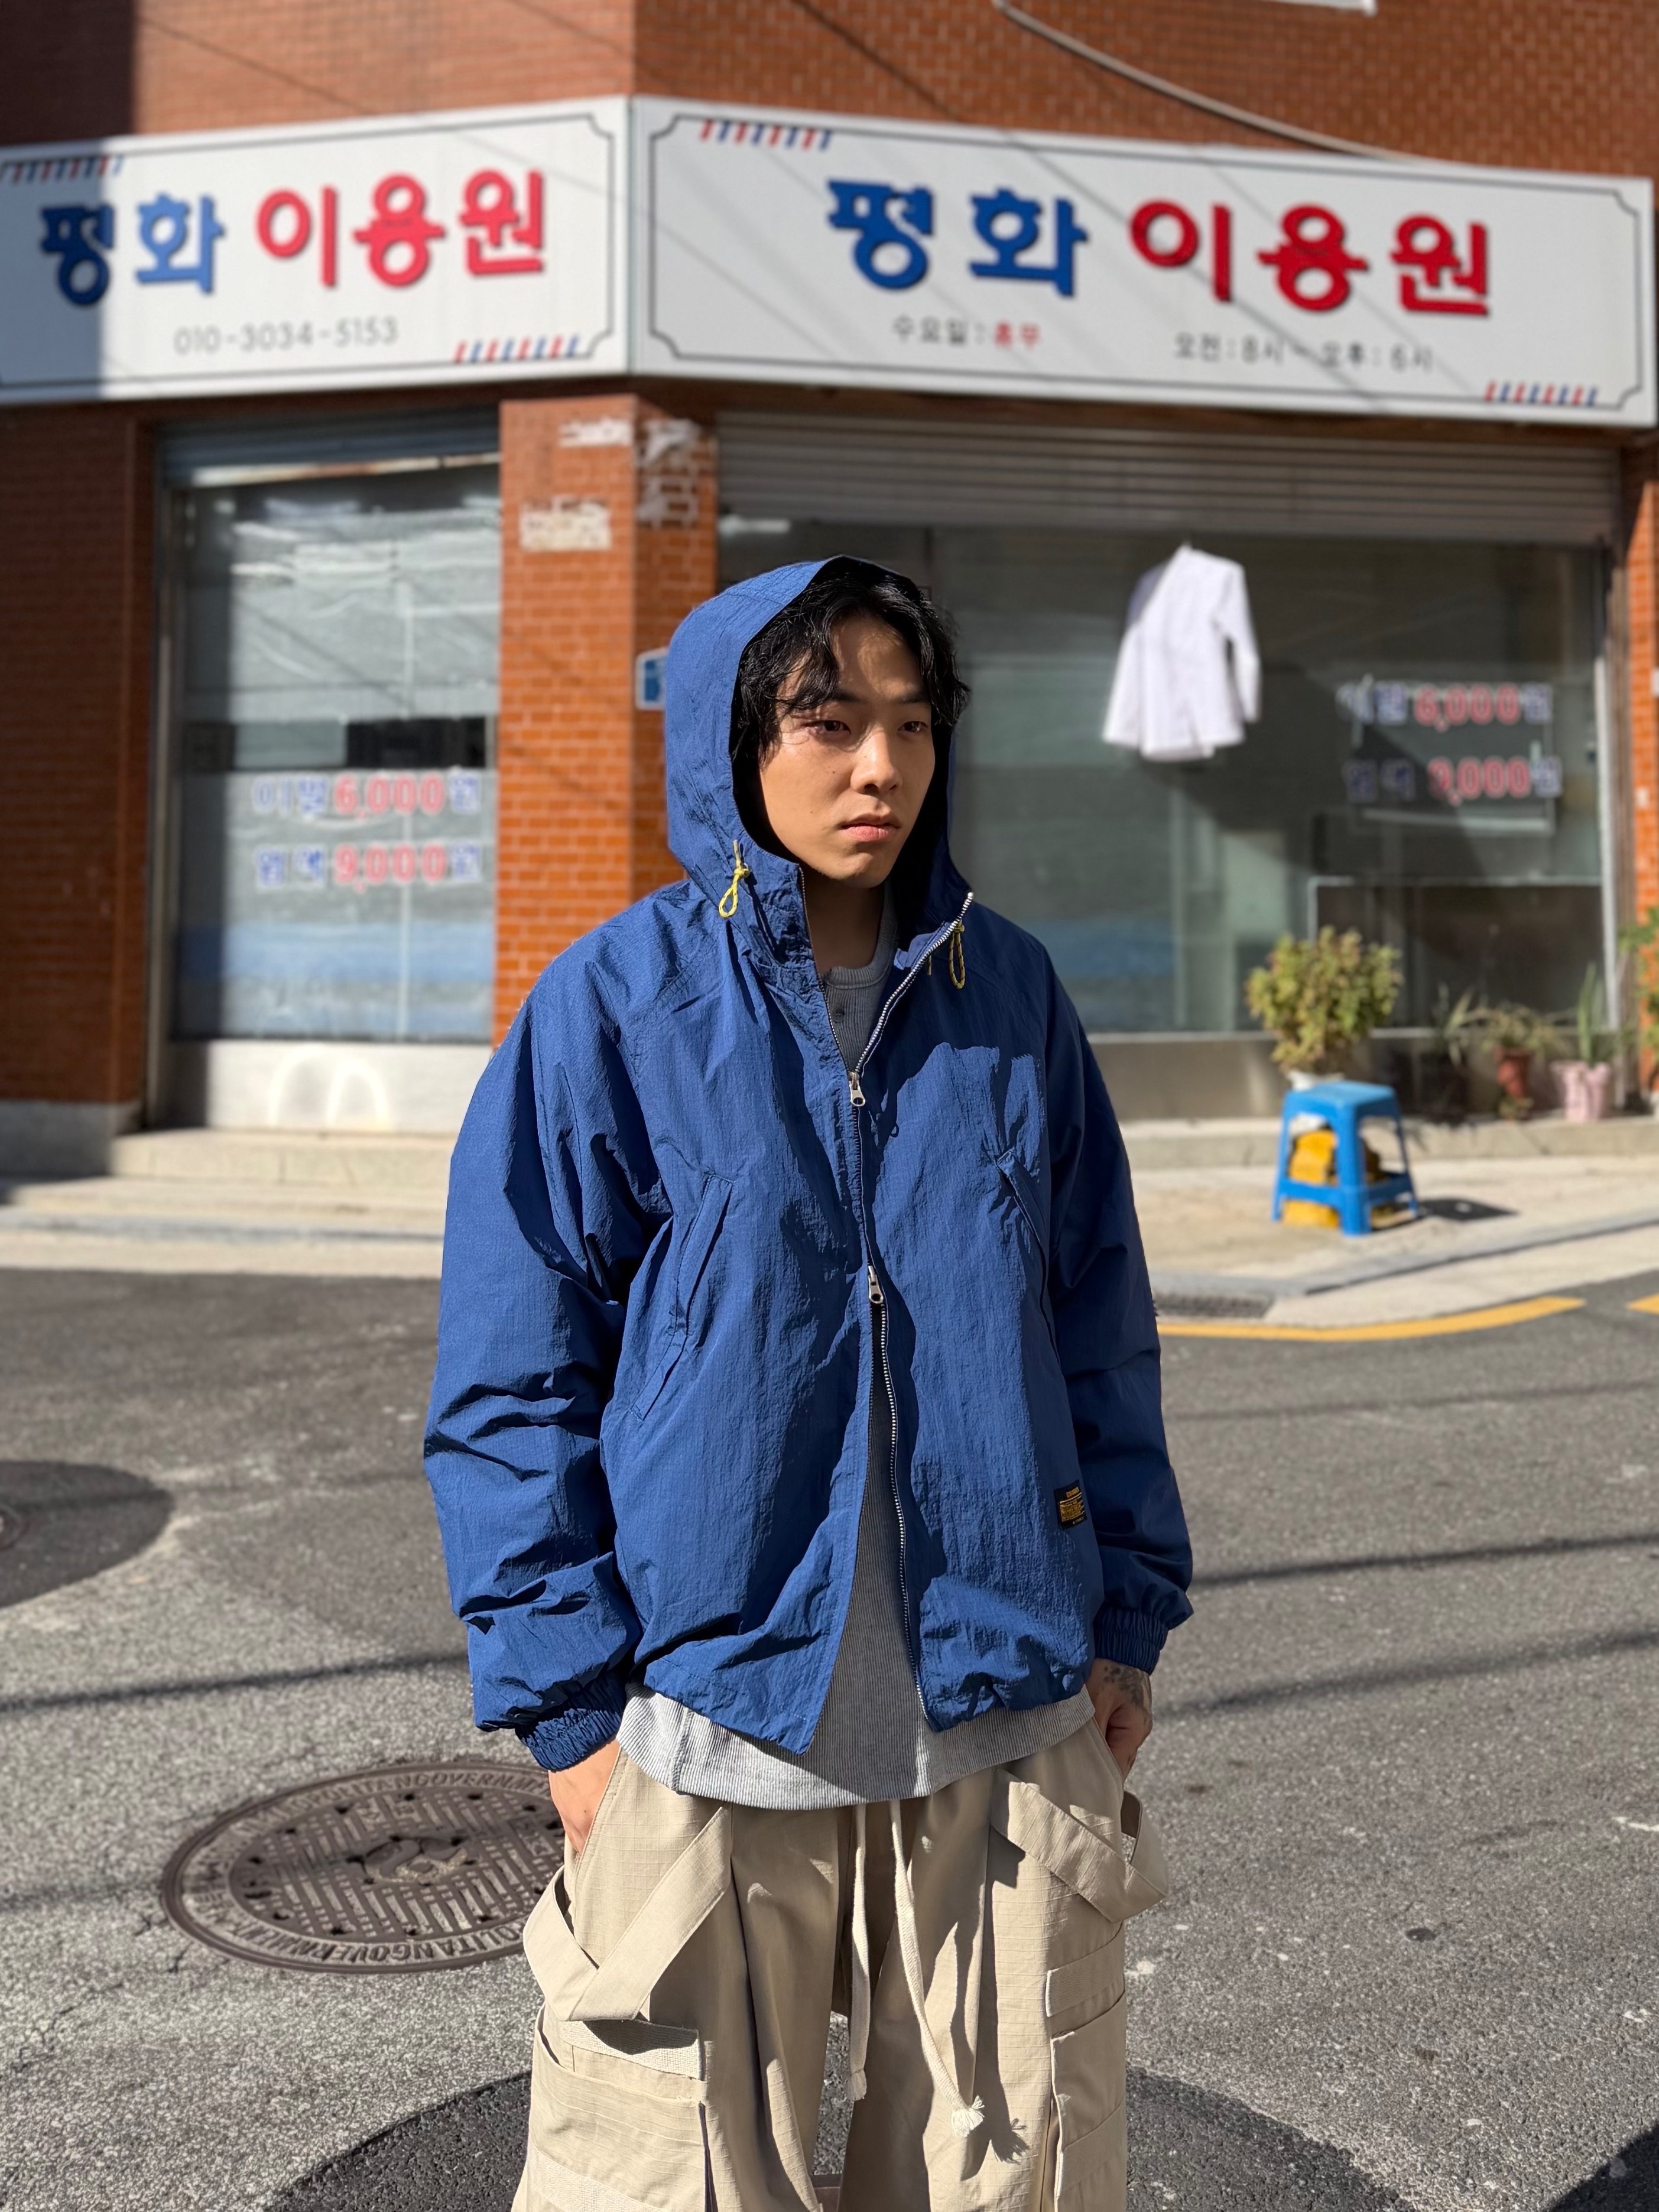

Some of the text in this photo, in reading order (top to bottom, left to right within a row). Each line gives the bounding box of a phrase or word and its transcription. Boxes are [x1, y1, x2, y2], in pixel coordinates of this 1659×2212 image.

[40, 170, 544, 308] 평화 이용원
[827, 179, 1490, 317] 평화 이용원
